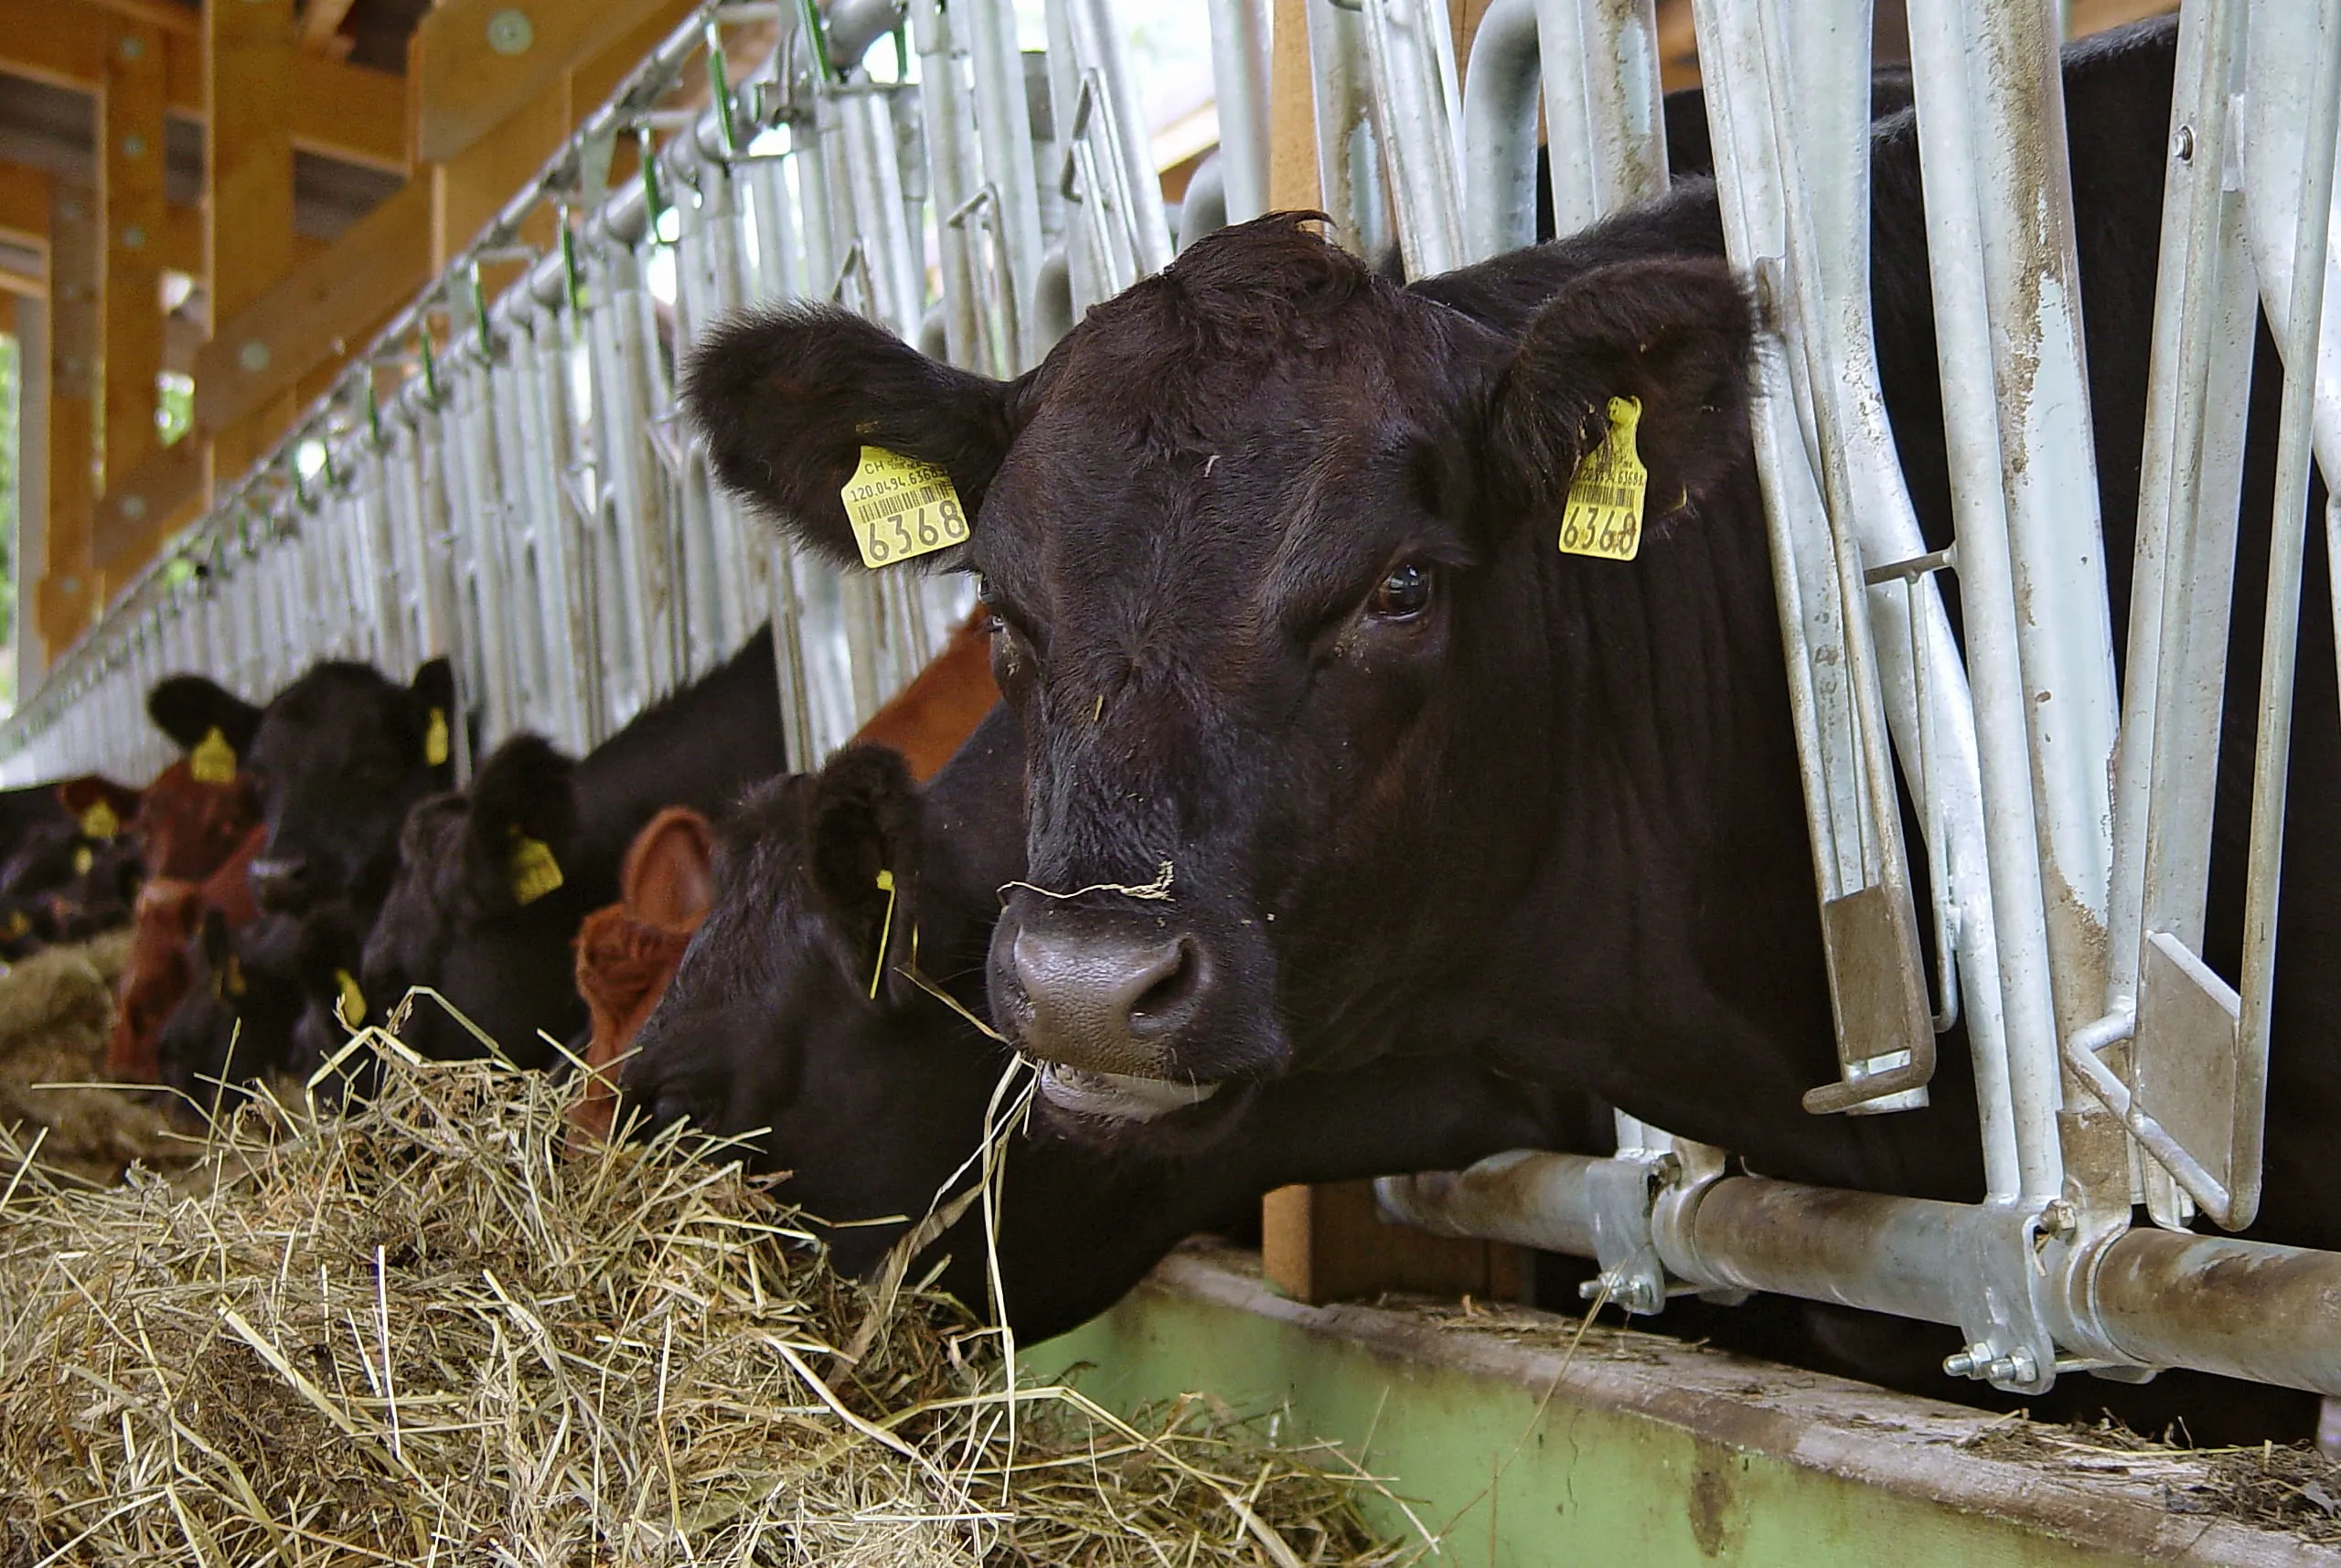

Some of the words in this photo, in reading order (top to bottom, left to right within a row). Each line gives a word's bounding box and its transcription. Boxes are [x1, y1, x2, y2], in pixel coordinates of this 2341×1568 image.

[864, 460, 884, 475] CH
[869, 500, 966, 561] 6368
[1563, 506, 1637, 556] 6368
